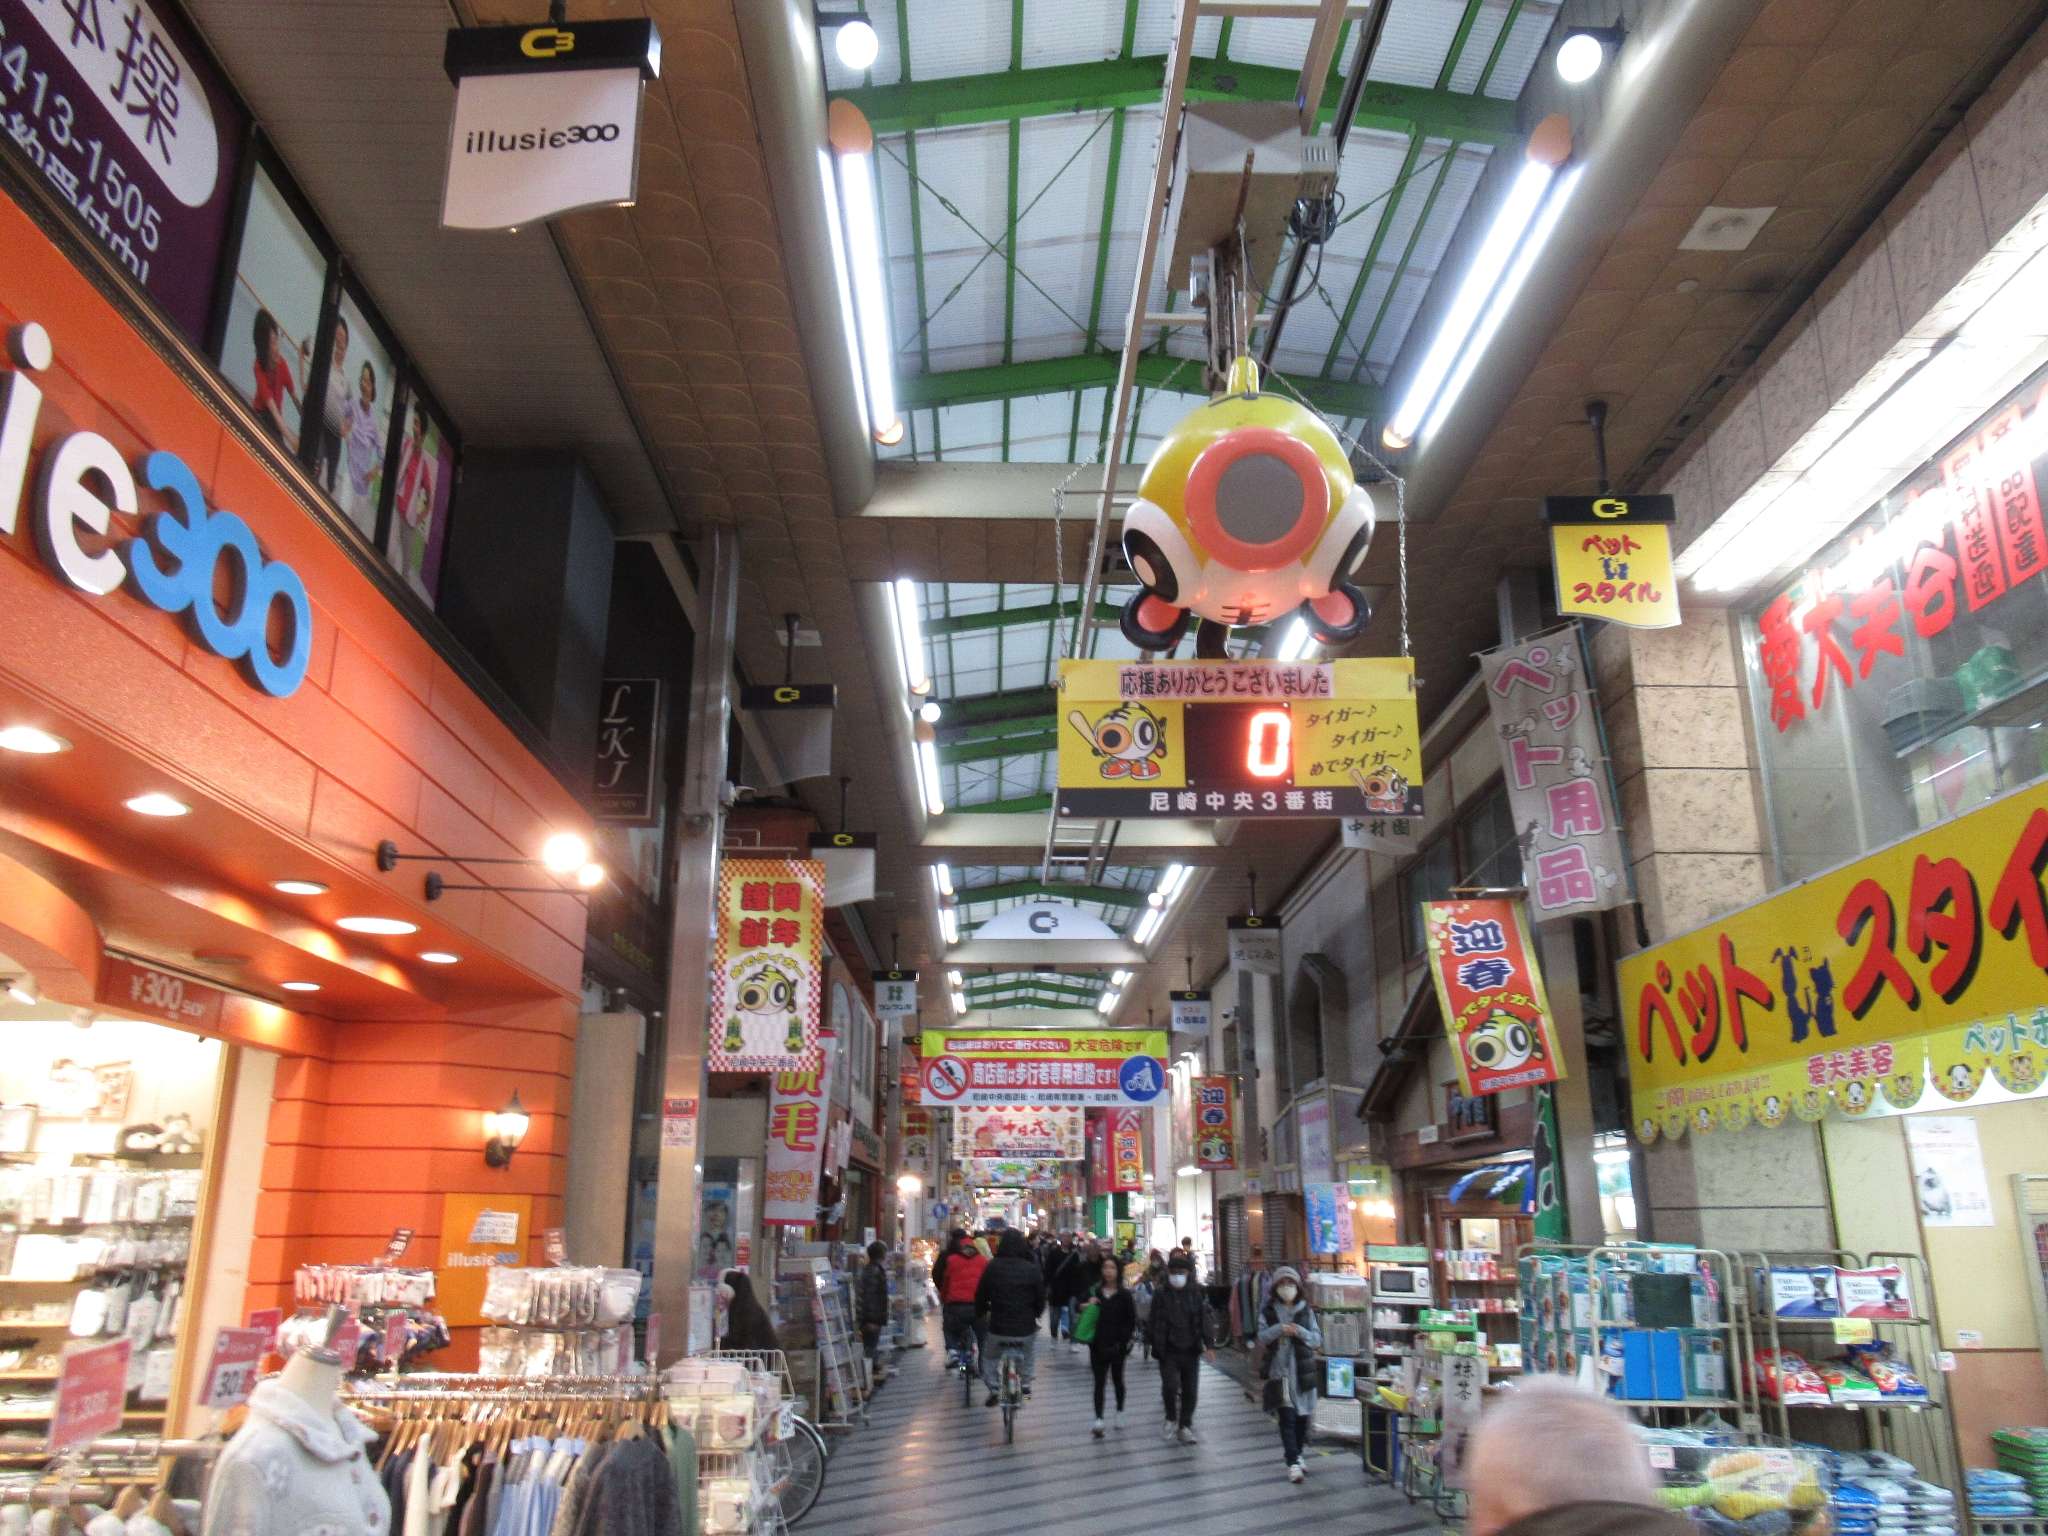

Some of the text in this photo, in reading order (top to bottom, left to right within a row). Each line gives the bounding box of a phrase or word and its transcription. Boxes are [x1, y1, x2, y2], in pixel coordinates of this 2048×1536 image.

[0, 18, 162, 253] 413-1505
[465, 122, 620, 154] illusie300
[1581, 533, 1642, 556] ペット
[1572, 580, 1662, 605] スタイル
[1119, 668, 1330, 698] 応援ありがとうございました
[1247, 711, 1292, 777] 0
[1494, 647, 1606, 909] ペット用品
[1150, 791, 1334, 812] 尼崎中央3番街
[738, 917, 801, 948] 新年
[1450, 918, 1516, 993] 迎春
[1638, 930, 1774, 1066] ペット
[1807, 1043, 1894, 1087] 愛犬美容
